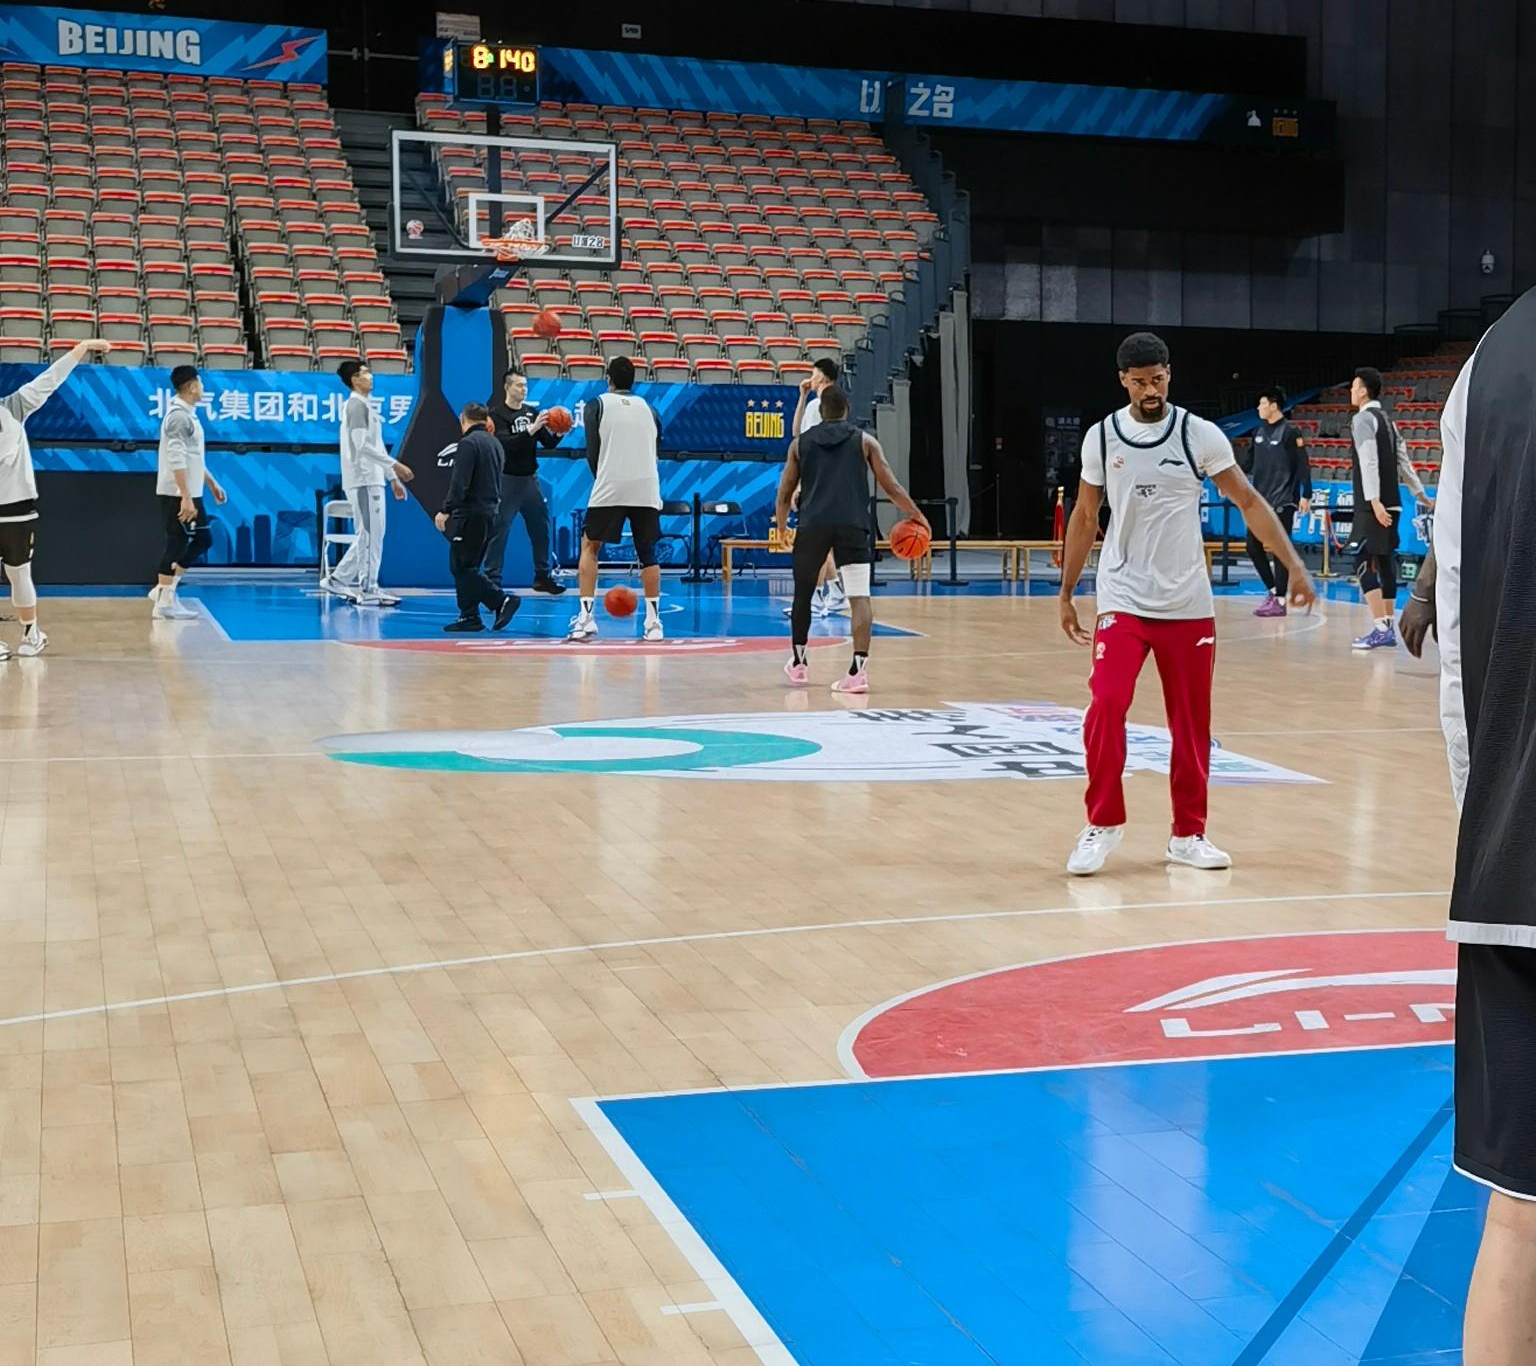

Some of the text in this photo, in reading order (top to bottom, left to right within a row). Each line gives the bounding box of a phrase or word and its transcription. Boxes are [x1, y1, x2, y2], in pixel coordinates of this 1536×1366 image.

[57, 18, 201, 66] BEIJING
[859, 79, 955, 119] 以之名
